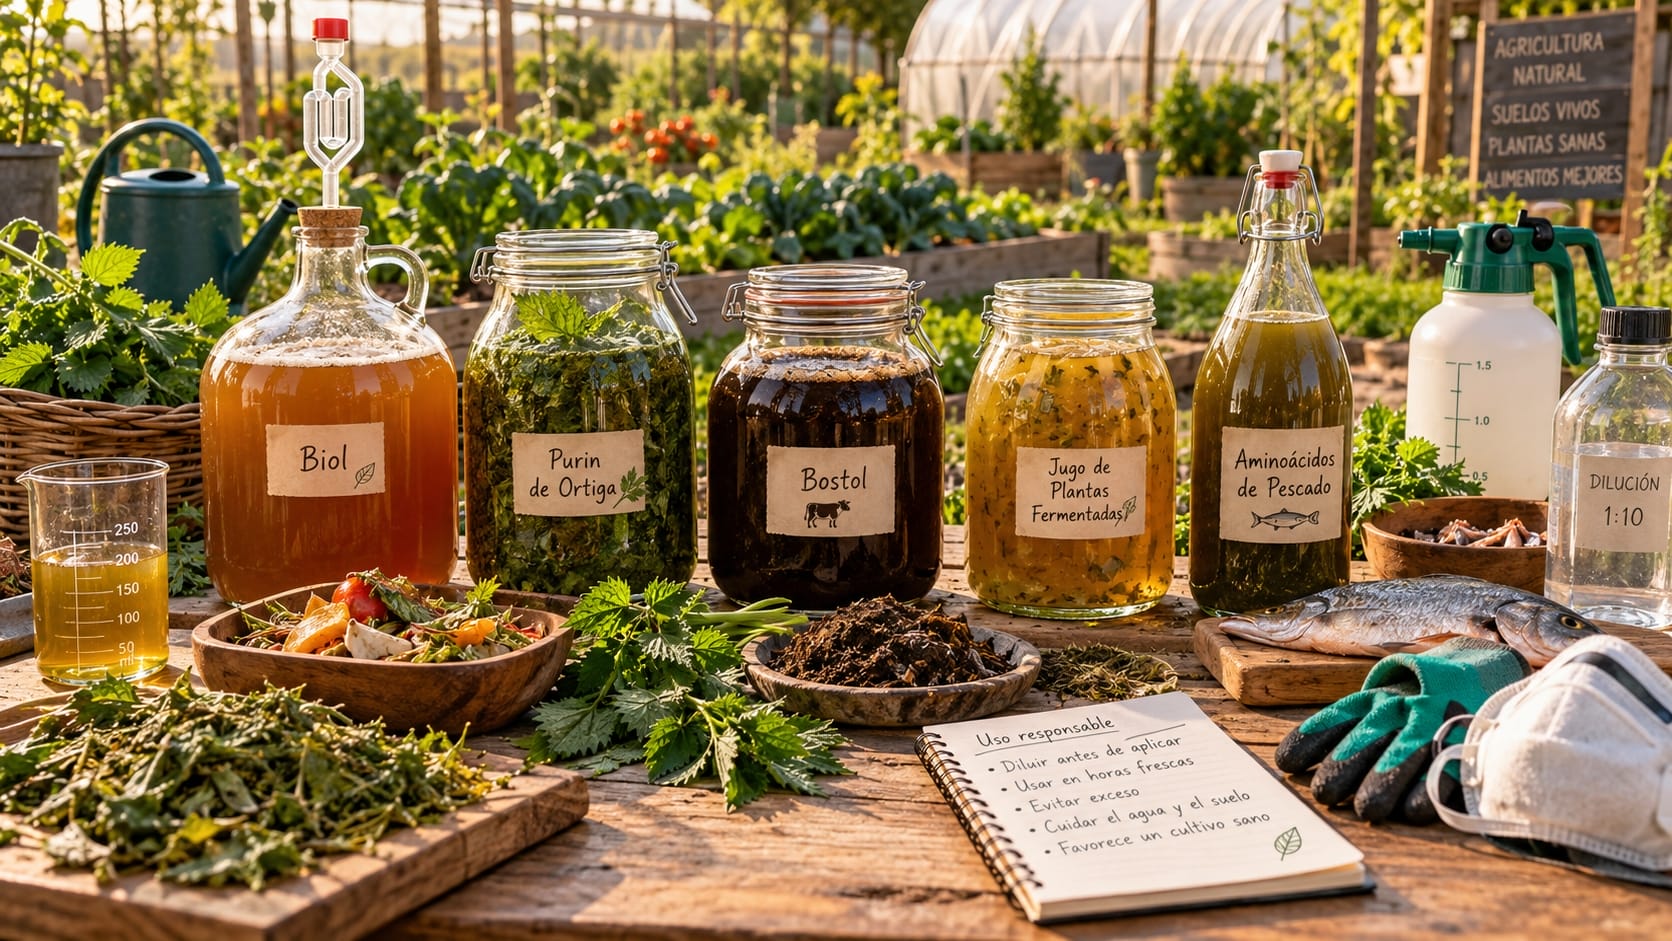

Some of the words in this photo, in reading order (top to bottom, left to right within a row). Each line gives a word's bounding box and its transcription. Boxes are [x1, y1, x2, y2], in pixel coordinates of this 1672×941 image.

[1494, 32, 1604, 59] AGRICULTURA
[1513, 62, 1586, 86] NATURAL
[1491, 102, 1550, 125] SUELOS
[1555, 99, 1601, 121] VIVOS
[1488, 134, 1553, 157] PLANTAS
[1558, 132, 1606, 153] SANAS
[1483, 167, 1559, 189] ALIMENTOS
[1563, 165, 1623, 188] MEJORES
[1476, 360, 1492, 370] 1.5
[1474, 416, 1490, 426] 1.0
[300, 444, 347, 472] Biol
[548, 448, 601, 470] Purin
[1048, 457, 1085, 482] Jugo
[1093, 456, 1111, 474] de
[1234, 446, 1335, 470] Aminoácidos
[800, 467, 867, 493] Bostol
[1237, 476, 1257, 497] de
[1267, 474, 1331, 498] Pescado
[1472, 471, 1488, 481] 0.5
[1589, 473, 1660, 491] DILUCIÓN
[529, 476, 549, 498] de
[559, 476, 617, 505] Ortiga
[1050, 481, 1109, 499] Plantas
[1032, 504, 1123, 523] Fermentadas
[1604, 506, 1644, 527] 1:10
[114, 521, 139, 537] 250
[115, 552, 139, 566] 200
[116, 582, 140, 597] 150
[117, 611, 140, 625] 100
[118, 640, 135, 655] 50
[976, 732, 1011, 747] Uso
[1018, 716, 1115, 743] responsable
[1000, 757, 1048, 773] Diluir
[1057, 751, 1099, 765] antes
[1106, 744, 1125, 757] de
[1131, 736, 1182, 755] aplicar
[1014, 779, 1053, 793] Usar
[1062, 776, 1081, 785] en
[1085, 766, 1131, 782] horas
[1137, 756, 1194, 774] frescas
[1028, 797, 1080, 813] Evitar
[1089, 788, 1140, 803] exceso
[1044, 816, 1098, 833] Cuidar
[1107, 809, 1121, 824] el
[1128, 807, 1167, 824] agua
[1172, 804, 1183, 817] y
[1190, 796, 1204, 810] el
[1211, 789, 1250, 807] suelo
[1057, 836, 1134, 856] Favorece
[1140, 831, 1163, 843] un
[1170, 821, 1225, 837] cultivo
[1233, 813, 1270, 827] sano
